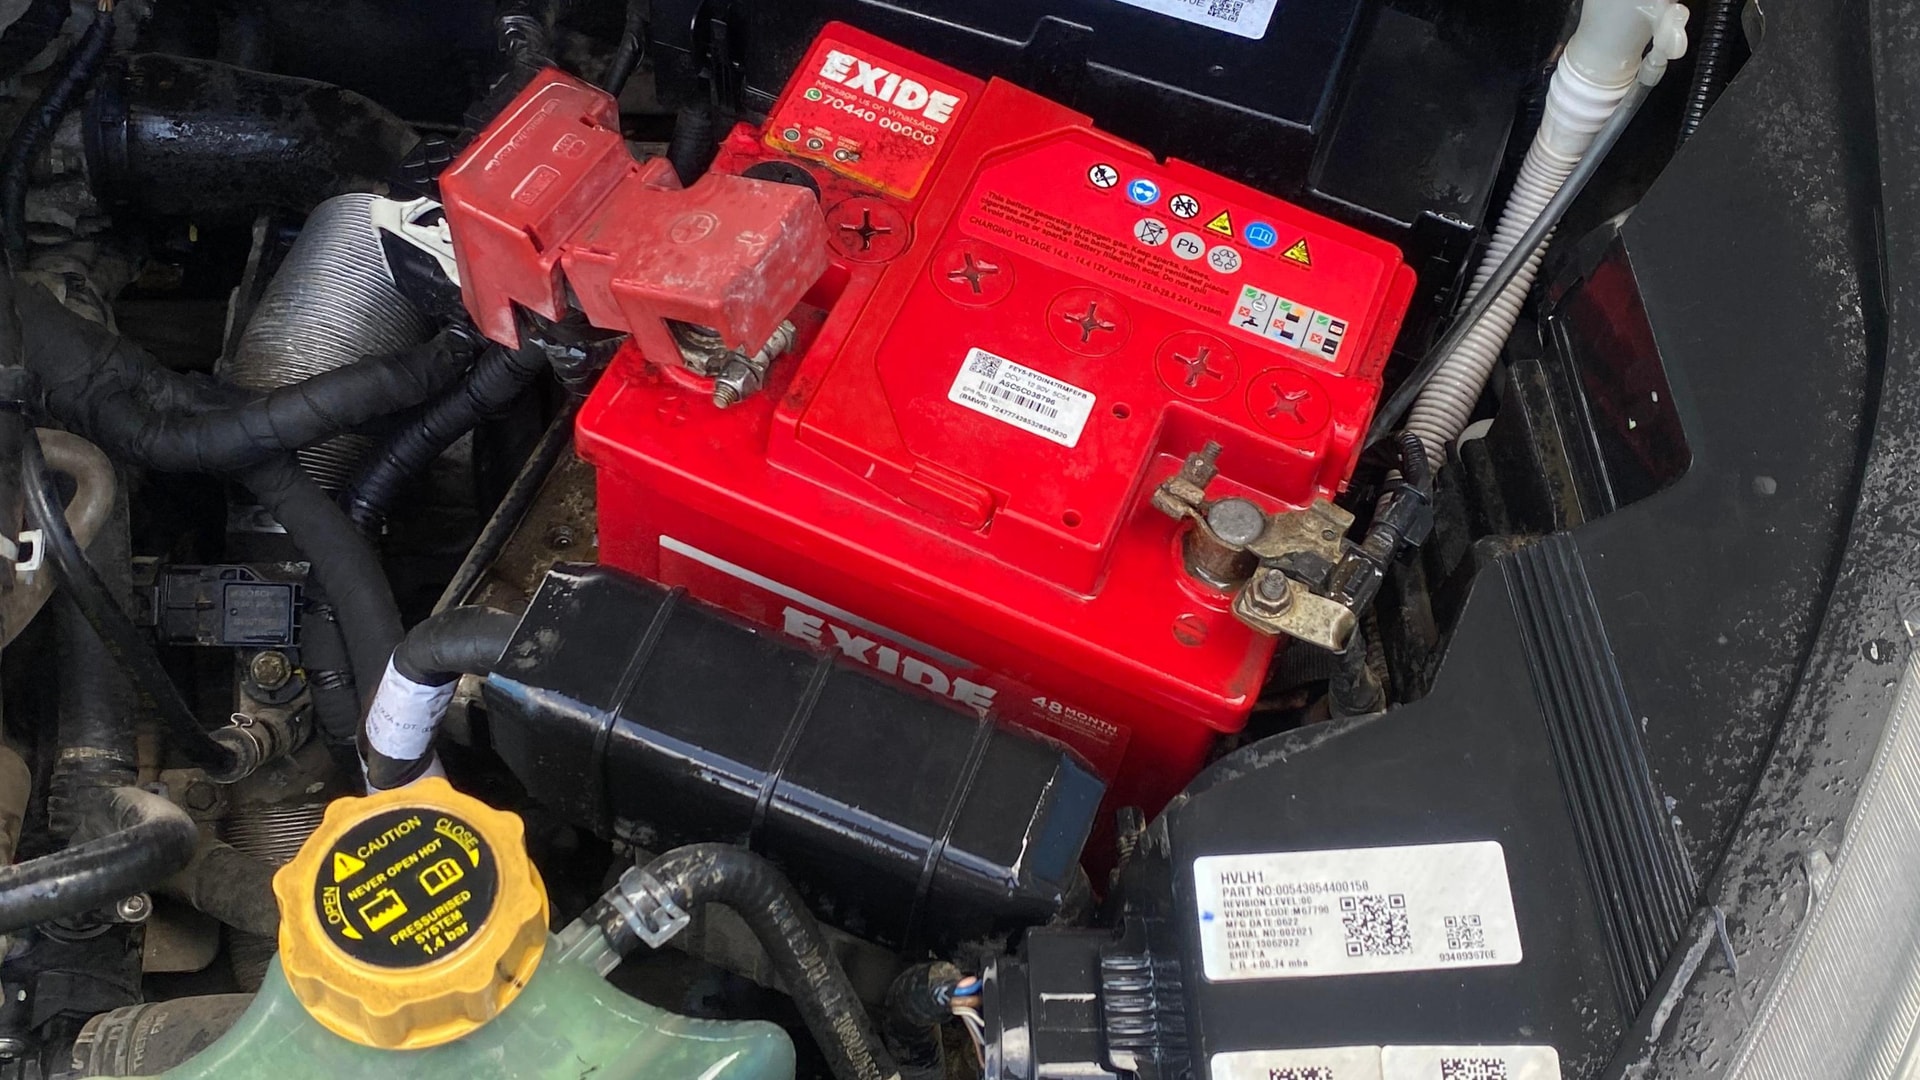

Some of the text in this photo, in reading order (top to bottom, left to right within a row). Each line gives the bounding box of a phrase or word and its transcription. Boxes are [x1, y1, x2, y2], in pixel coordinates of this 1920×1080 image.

[819, 50, 960, 124] EXIDE
[816, 80, 939, 133] Message us on WhatsApp
[823, 94, 876, 122] 70440
[879, 117, 935, 145] 00000
[987, 191, 1005, 202] This
[1005, 198, 1033, 213] battery
[1073, 224, 1111, 243] Hydrogen
[1130, 246, 1151, 258] Keep
[980, 205, 1003, 217] Avoid
[1006, 215, 1030, 227] shorts
[1041, 228, 1068, 242] sparks
[1072, 240, 1101, 255] Battery
[1102, 251, 1122, 262] filled
[1123, 258, 1140, 269] with
[1162, 273, 1174, 282] Do
[1175, 278, 1188, 287] not
[980, 197, 1019, 215] cigarettes
[1019, 212, 1039, 224] away
[1044, 221, 1073, 236] Charge
[1074, 232, 1089, 241] this
[1090, 238, 1117, 253] battery
[1118, 250, 1136, 261] only
[1147, 260, 1163, 270] well
[1203, 282, 1229, 296] places
[1177, 238, 1198, 254] Pb
[968, 215, 1013, 237] CHARGING
[1013, 232, 1051, 251] VOLTAGE
[1074, 256, 1090, 266] 14.4
[1093, 263, 1107, 272] 12V
[1107, 269, 1136, 285] system
[1177, 295, 1192, 305] 24V
[1193, 302, 1222, 318] system
[782, 606, 997, 709] EXIDE
[1032, 696, 1063, 714] 48
[1065, 706, 1118, 732] MONTH
[357, 816, 422, 860] CAUTION
[435, 818, 479, 851] CLOSE
[347, 838, 444, 902] NEVER OPEN HOT
[1220, 870, 1264, 885] HVLH1
[323, 886, 339, 924] OPEN
[1222, 886, 1253, 898] PART
[1223, 898, 1266, 908] REVISION
[389, 890, 472, 946] PRESSURISED
[414, 911, 464, 944] SYSTEM
[1224, 909, 1261, 919] VENDER
[1225, 919, 1245, 929] MFG
[422, 922, 471, 956] 1.4 bar
[1226, 929, 1258, 939] SERIAL
